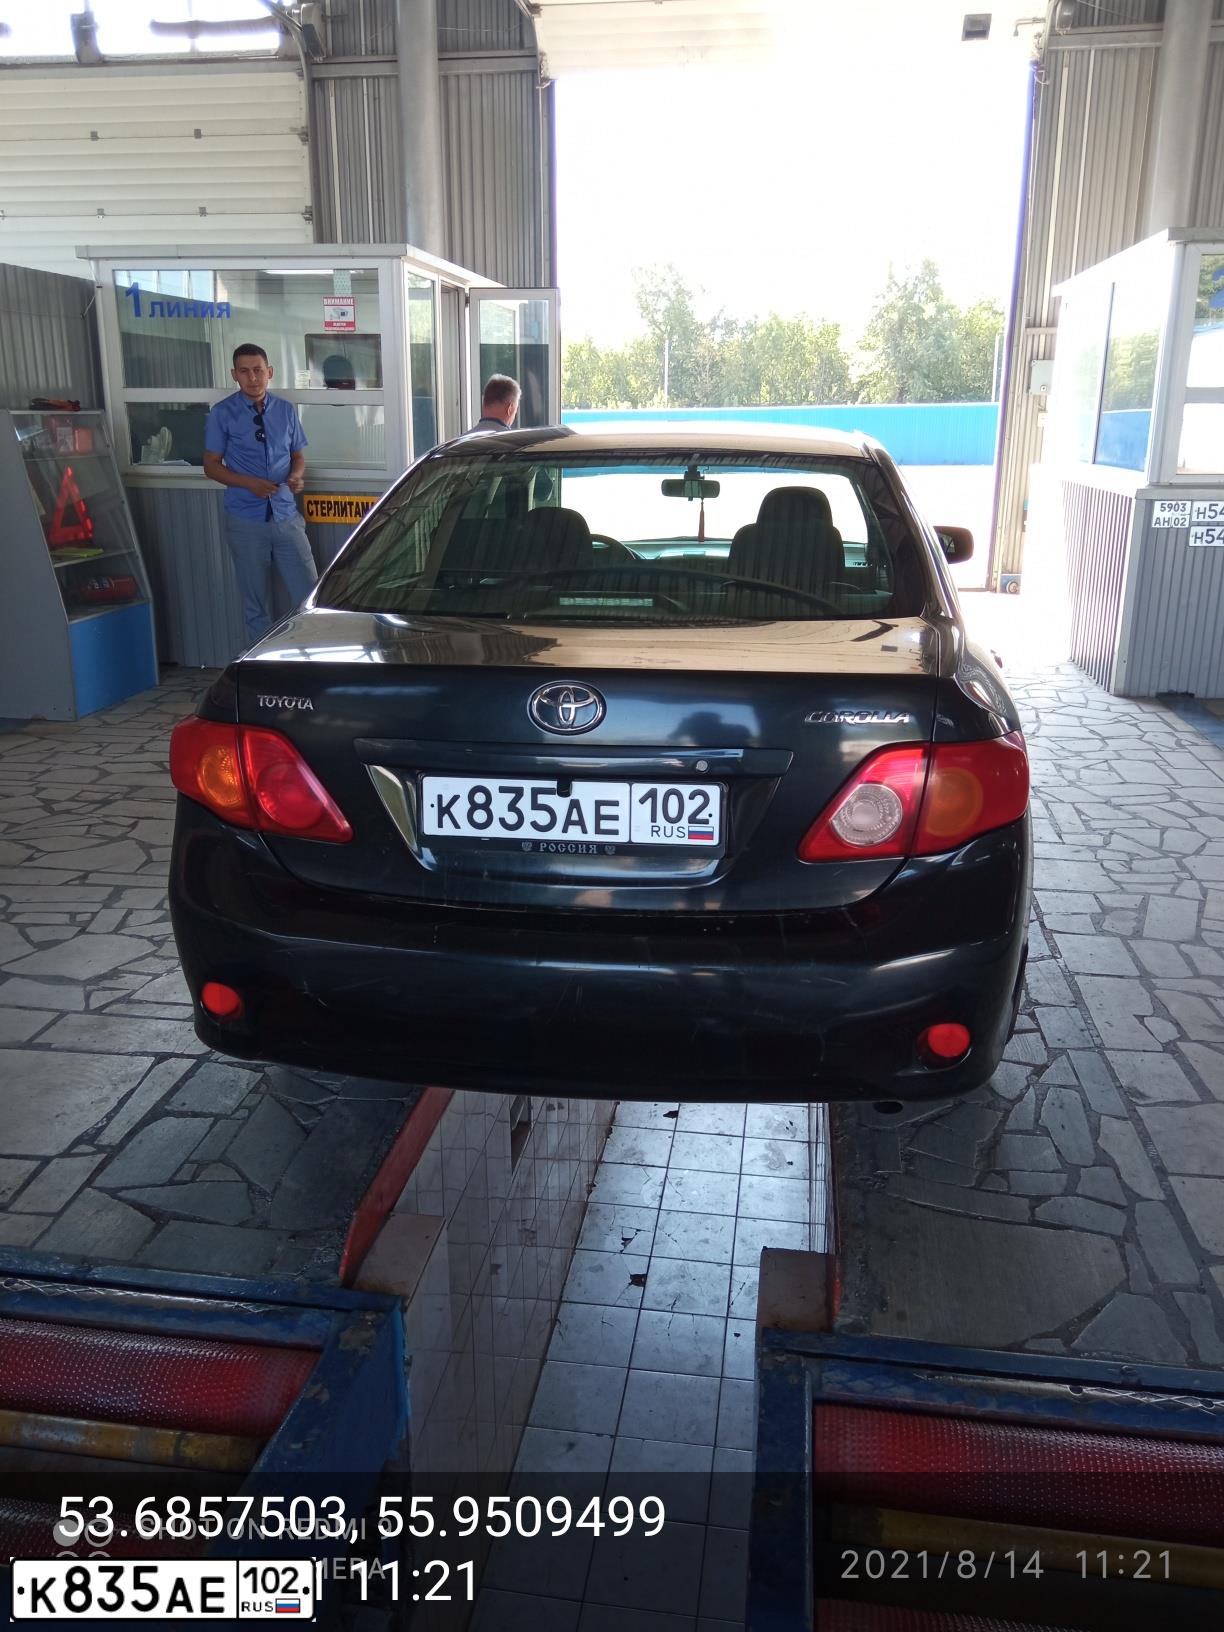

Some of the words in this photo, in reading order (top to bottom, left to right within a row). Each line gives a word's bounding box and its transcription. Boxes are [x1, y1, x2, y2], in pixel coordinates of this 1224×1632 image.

[126, 282, 142, 318] 1
[306, 500, 375, 518] СТЕРЛИТАМ
[1160, 502, 1187, 512] 5903
[257, 694, 314, 710] TOYOTA
[804, 710, 910, 724] COROLLA
[638, 787, 710, 825] 102
[650, 825, 686, 838] RUS
[539, 842, 598, 855] РОССИЯ
